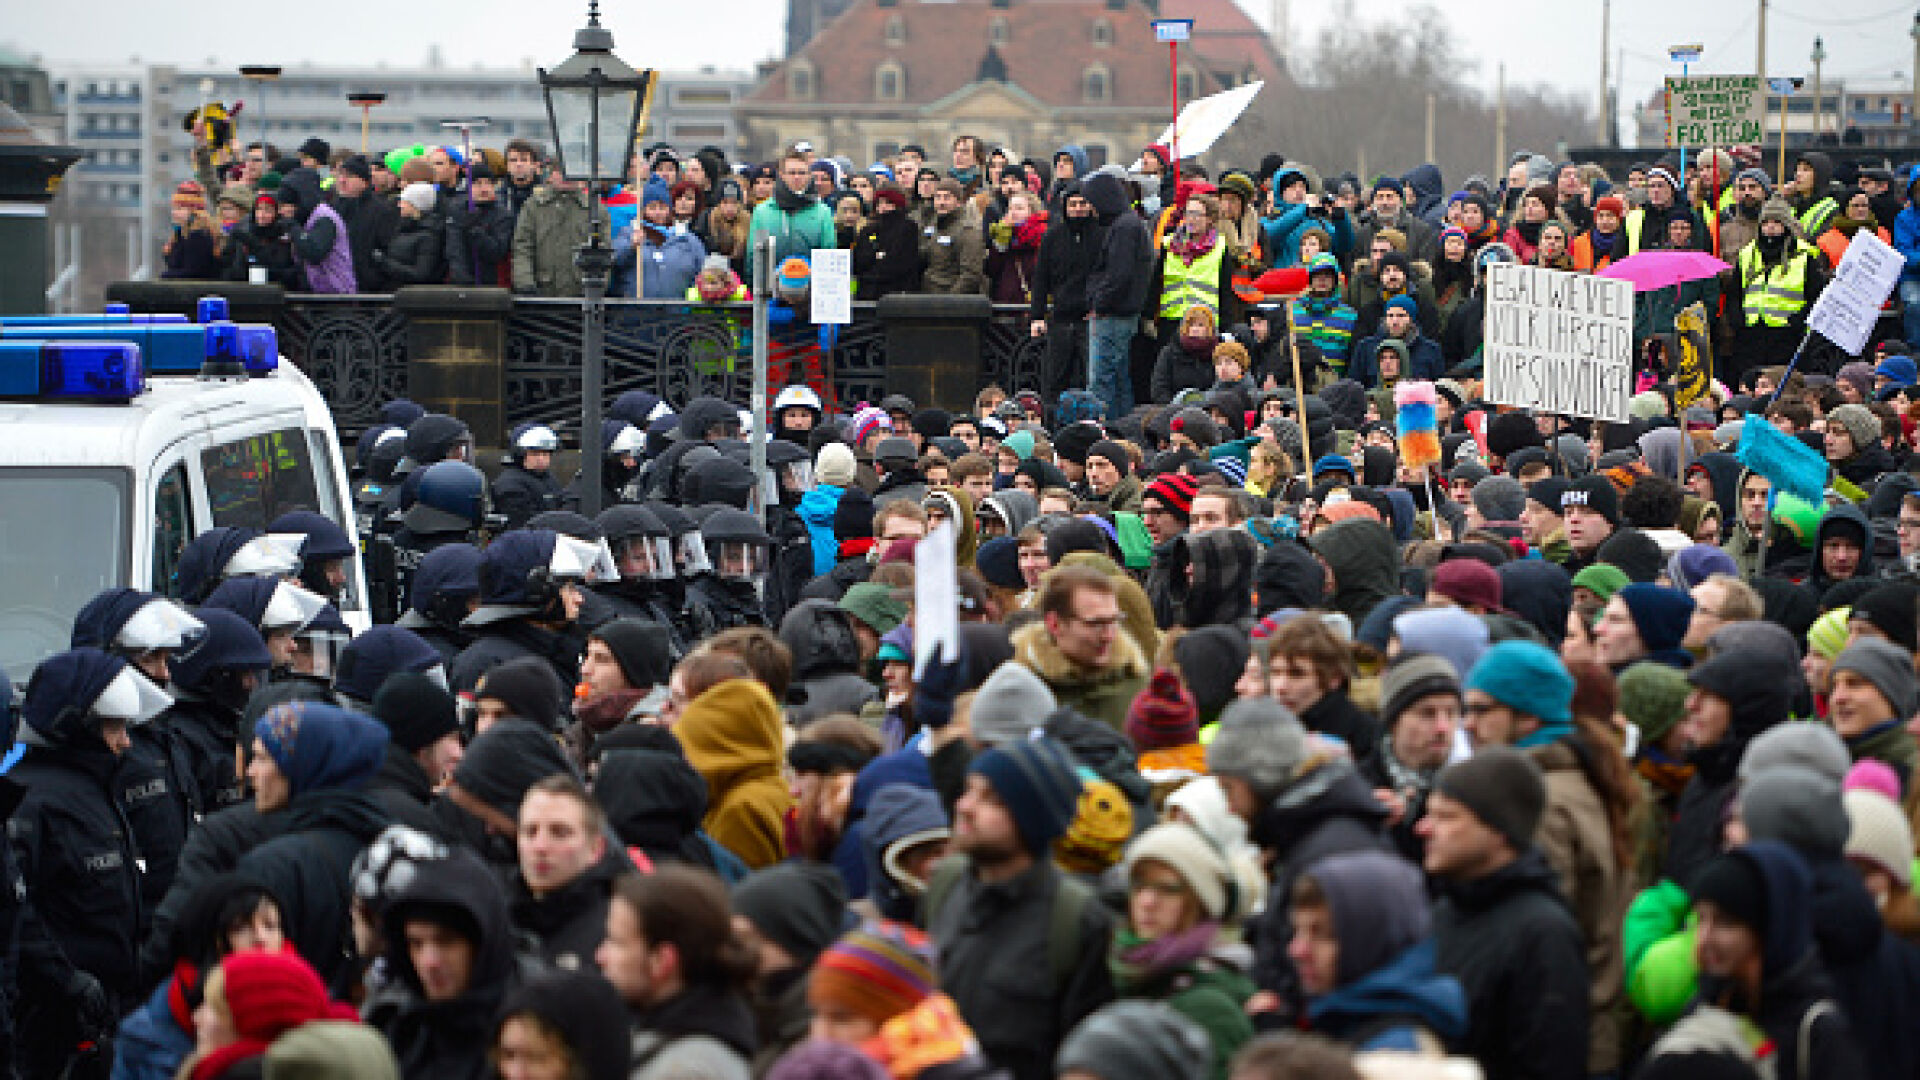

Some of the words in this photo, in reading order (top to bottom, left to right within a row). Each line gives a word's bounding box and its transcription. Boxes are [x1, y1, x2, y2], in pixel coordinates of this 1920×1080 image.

[1492, 264, 1542, 307] EGAL
[1490, 304, 1542, 349] VOLK
[1547, 311, 1582, 353] IHR
